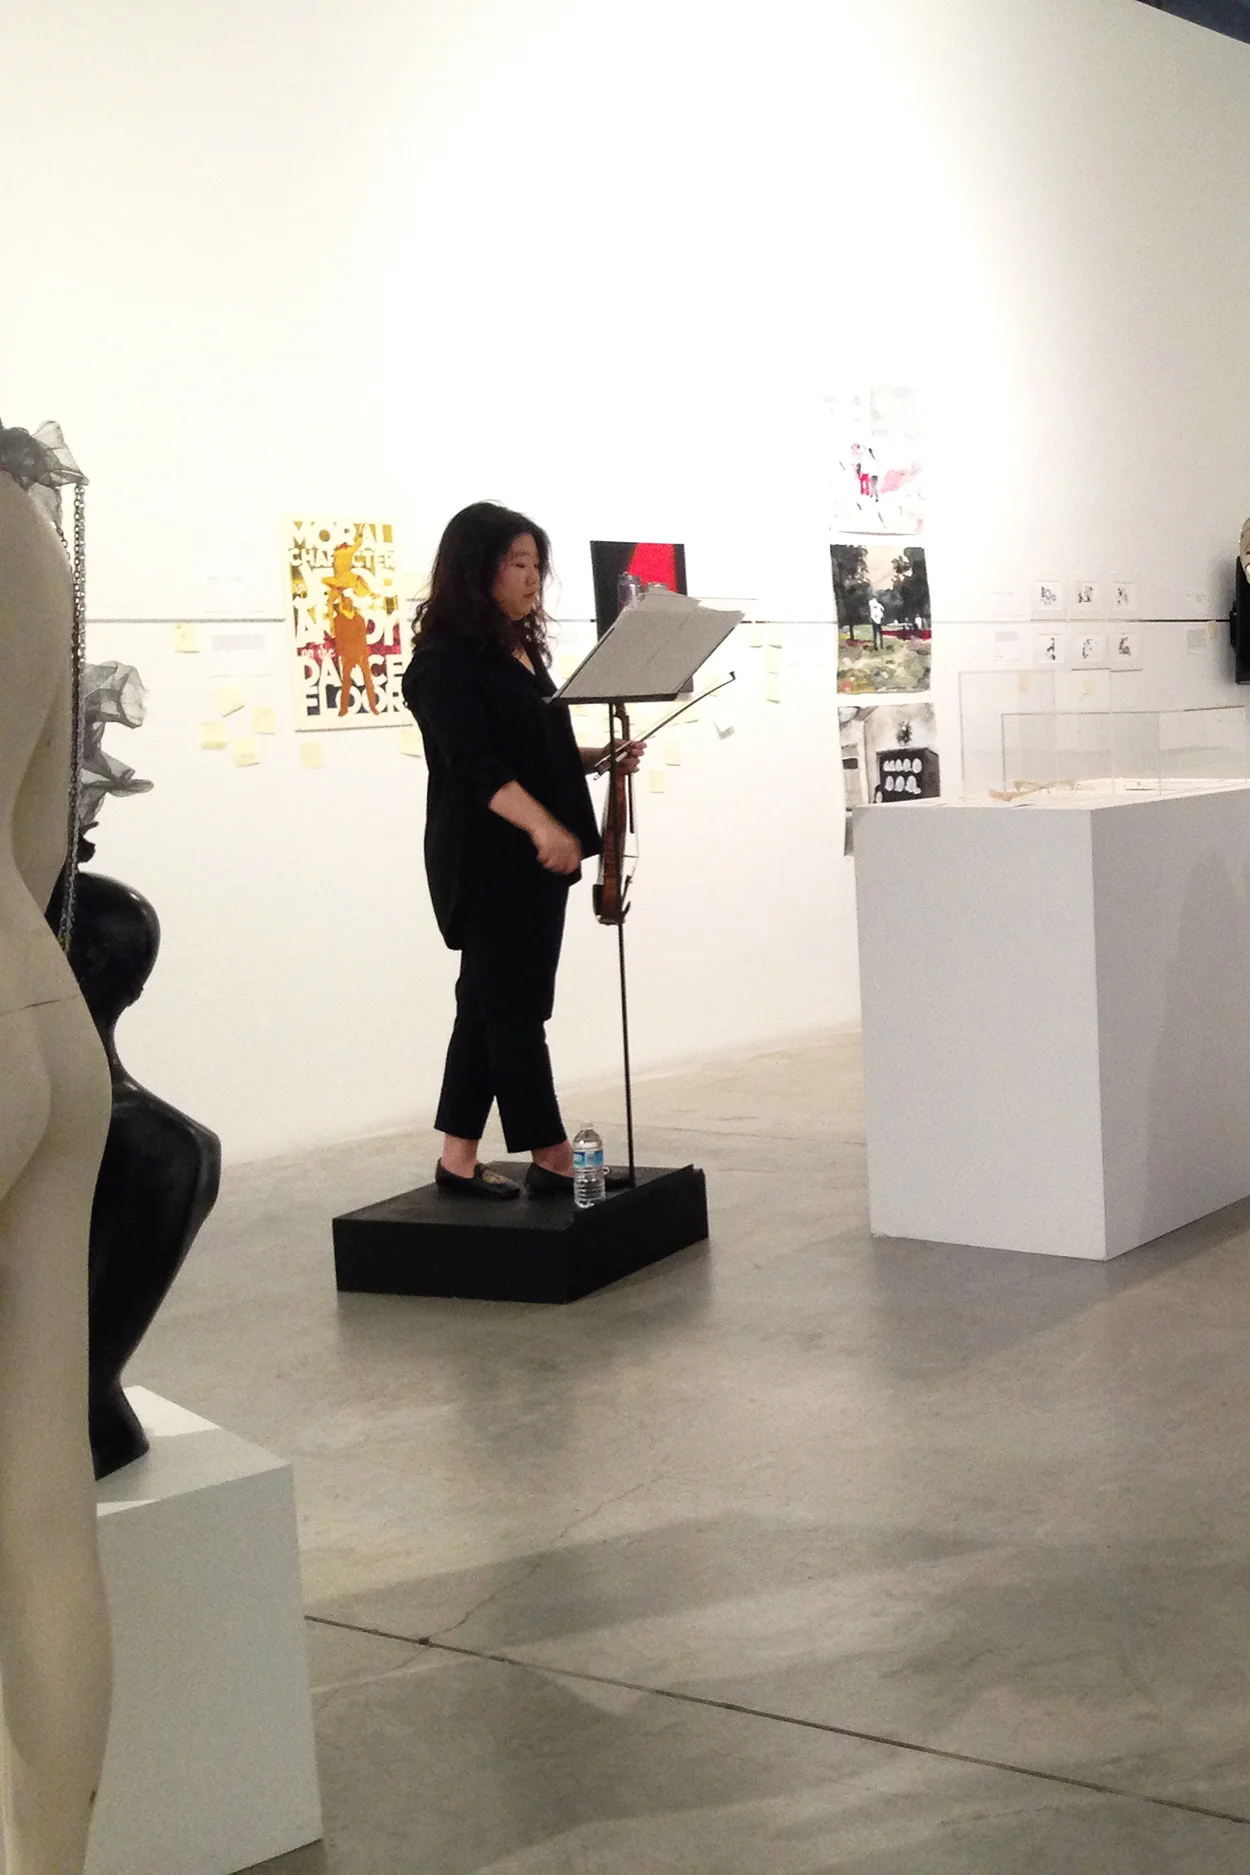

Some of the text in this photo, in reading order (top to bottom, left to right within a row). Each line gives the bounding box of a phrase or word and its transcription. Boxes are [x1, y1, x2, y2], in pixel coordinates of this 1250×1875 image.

[288, 520, 396, 547] MORAL
[296, 655, 403, 687] DANCE
[297, 685, 403, 715] FLOOR
